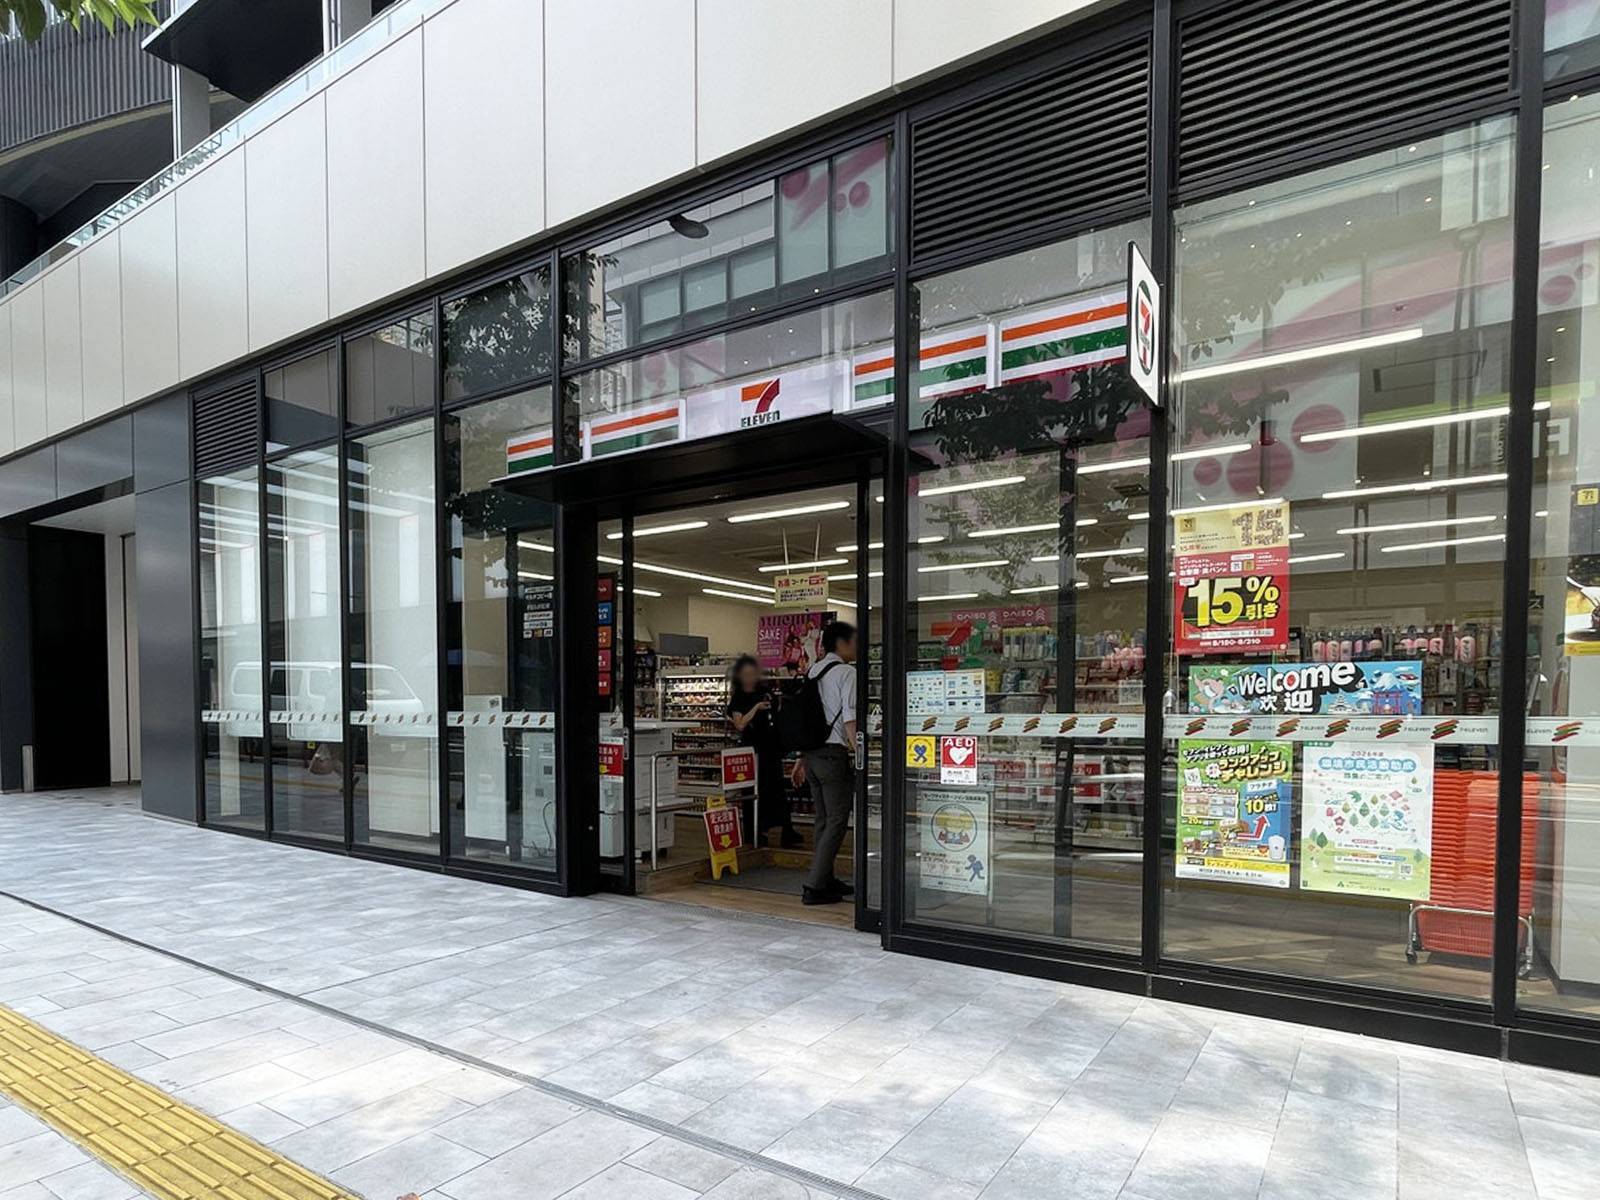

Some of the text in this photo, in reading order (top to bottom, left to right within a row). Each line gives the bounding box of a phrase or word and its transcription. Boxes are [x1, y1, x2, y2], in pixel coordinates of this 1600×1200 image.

[741, 378, 780, 414] 7
[1246, 603, 1278, 620] 引き
[1239, 662, 1356, 696] Welcome
[1260, 690, 1313, 712] 欢迎
[944, 738, 974, 747] AED
[1221, 760, 1288, 782] チャレンジ
